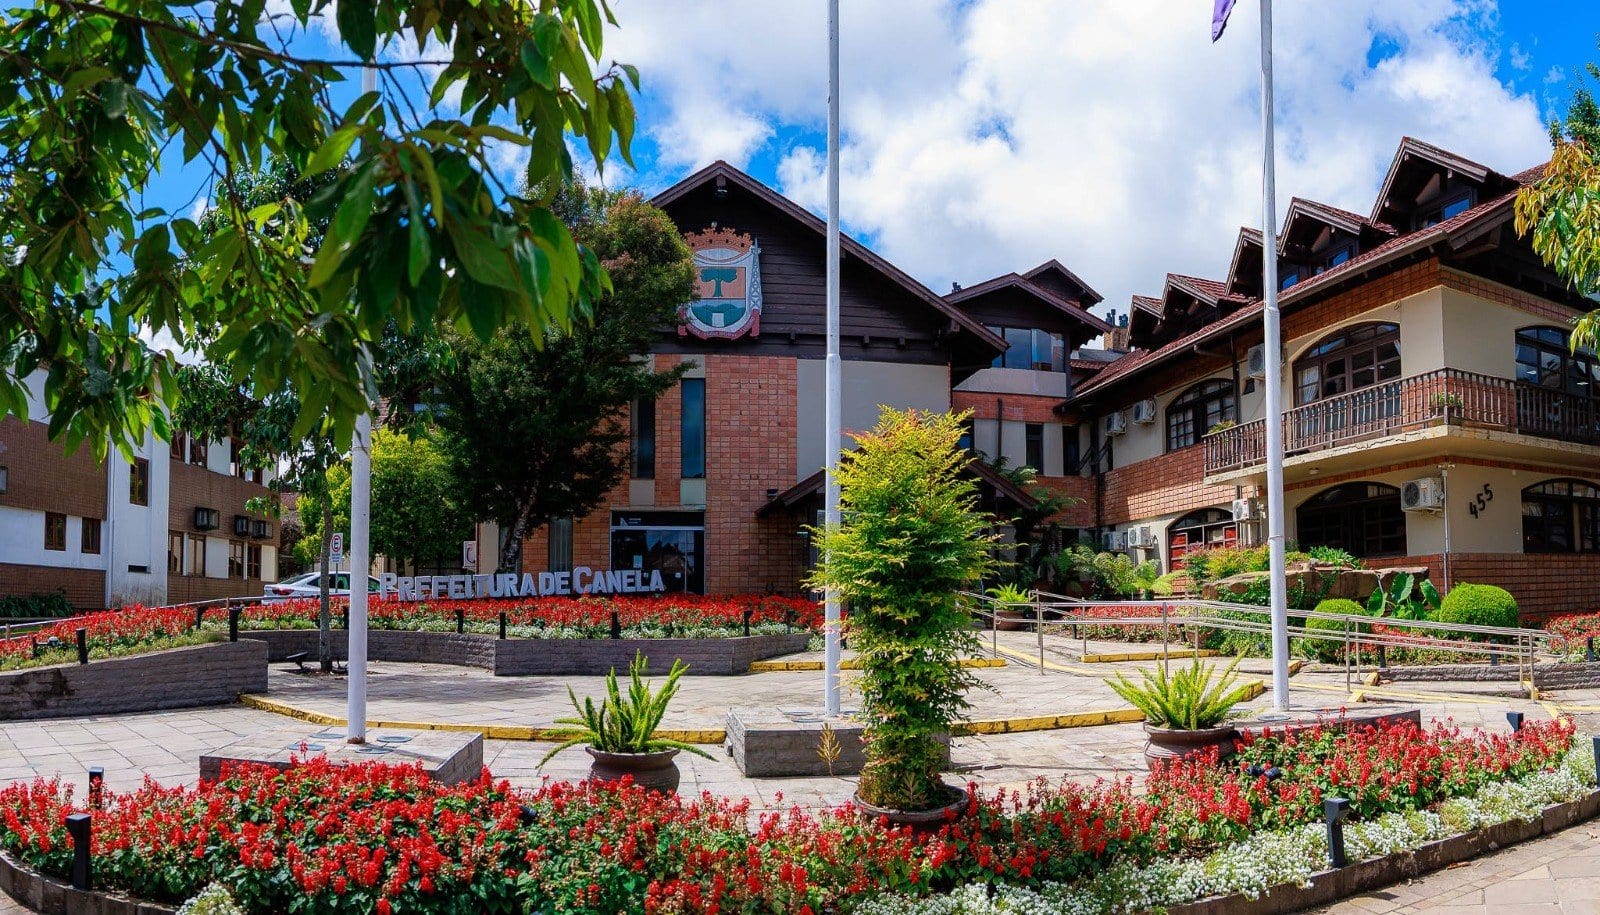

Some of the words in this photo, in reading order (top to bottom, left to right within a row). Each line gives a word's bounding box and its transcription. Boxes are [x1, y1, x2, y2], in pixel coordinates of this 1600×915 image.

[1469, 483, 1493, 519] 455
[380, 572, 537, 601] PREFEITURA
[538, 571, 571, 596] DE
[572, 566, 665, 594] CANELA
